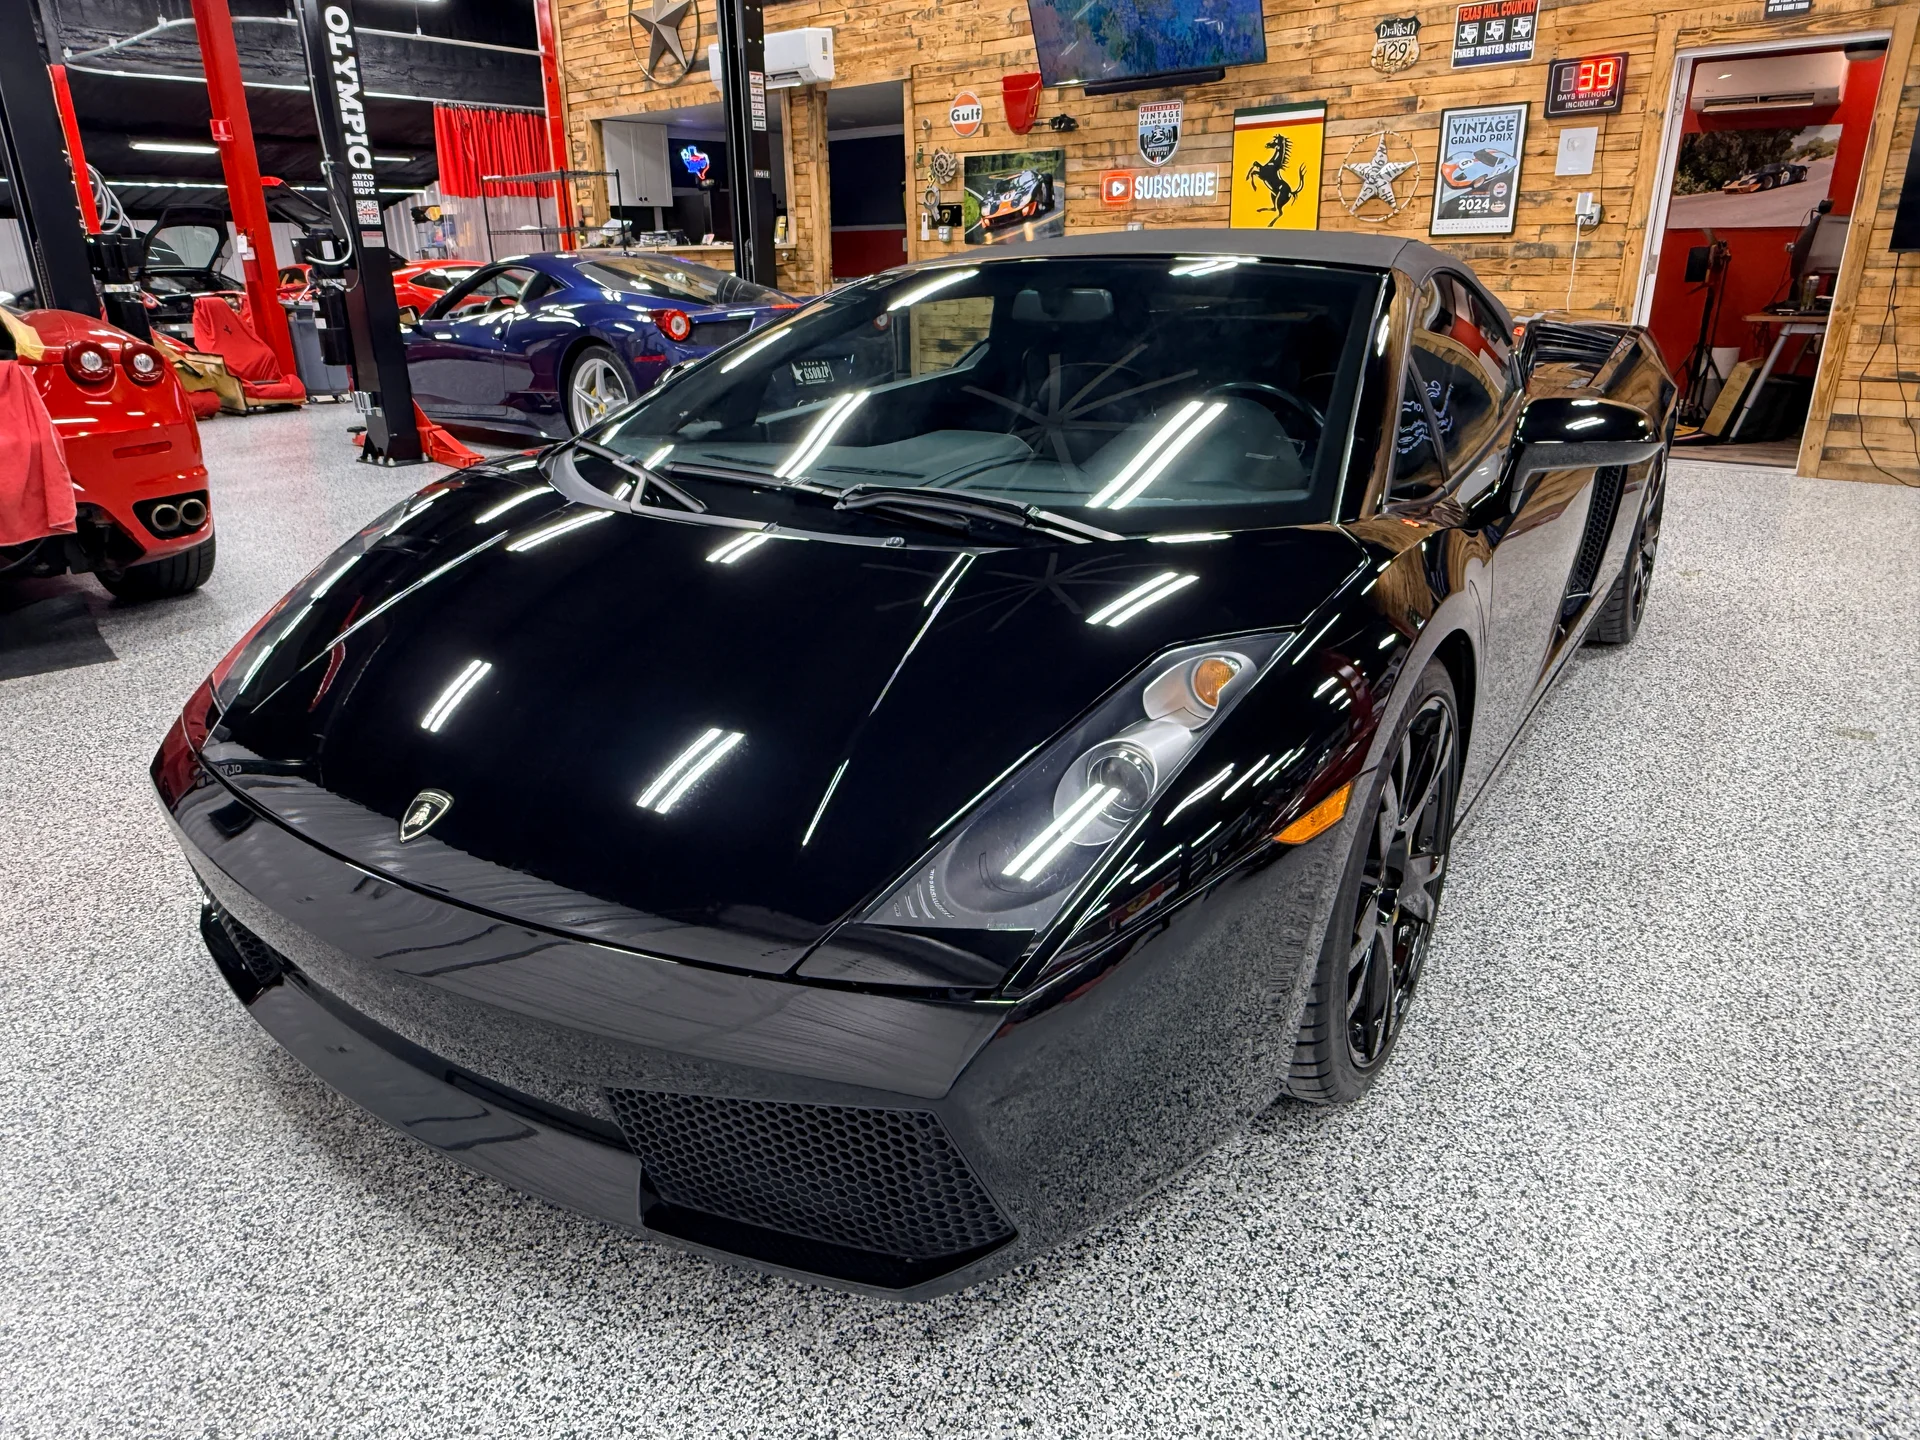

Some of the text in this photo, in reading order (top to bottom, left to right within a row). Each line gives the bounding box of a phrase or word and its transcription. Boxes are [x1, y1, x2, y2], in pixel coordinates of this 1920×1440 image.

[1459, 0, 1537, 22] TEXAS HILL COUNTRY
[1454, 40, 1533, 59] THREE TWISTED SISTERS
[324, 5, 373, 169] OLYMPIC
[1557, 89, 1612, 102] DAYS WITHOUT
[1565, 99, 1599, 109] INCIDENT
[951, 108, 981, 122] Gulf
[1140, 110, 1180, 120] VINTAGE
[1453, 119, 1516, 135] VINTAGE
[1451, 132, 1514, 145] GRAND PRIX
[352, 180, 375, 188] SHOP
[1134, 171, 1216, 200] SUBSCRIBE
[353, 187, 376, 195] EQPT
[1458, 198, 1490, 211] 2024
